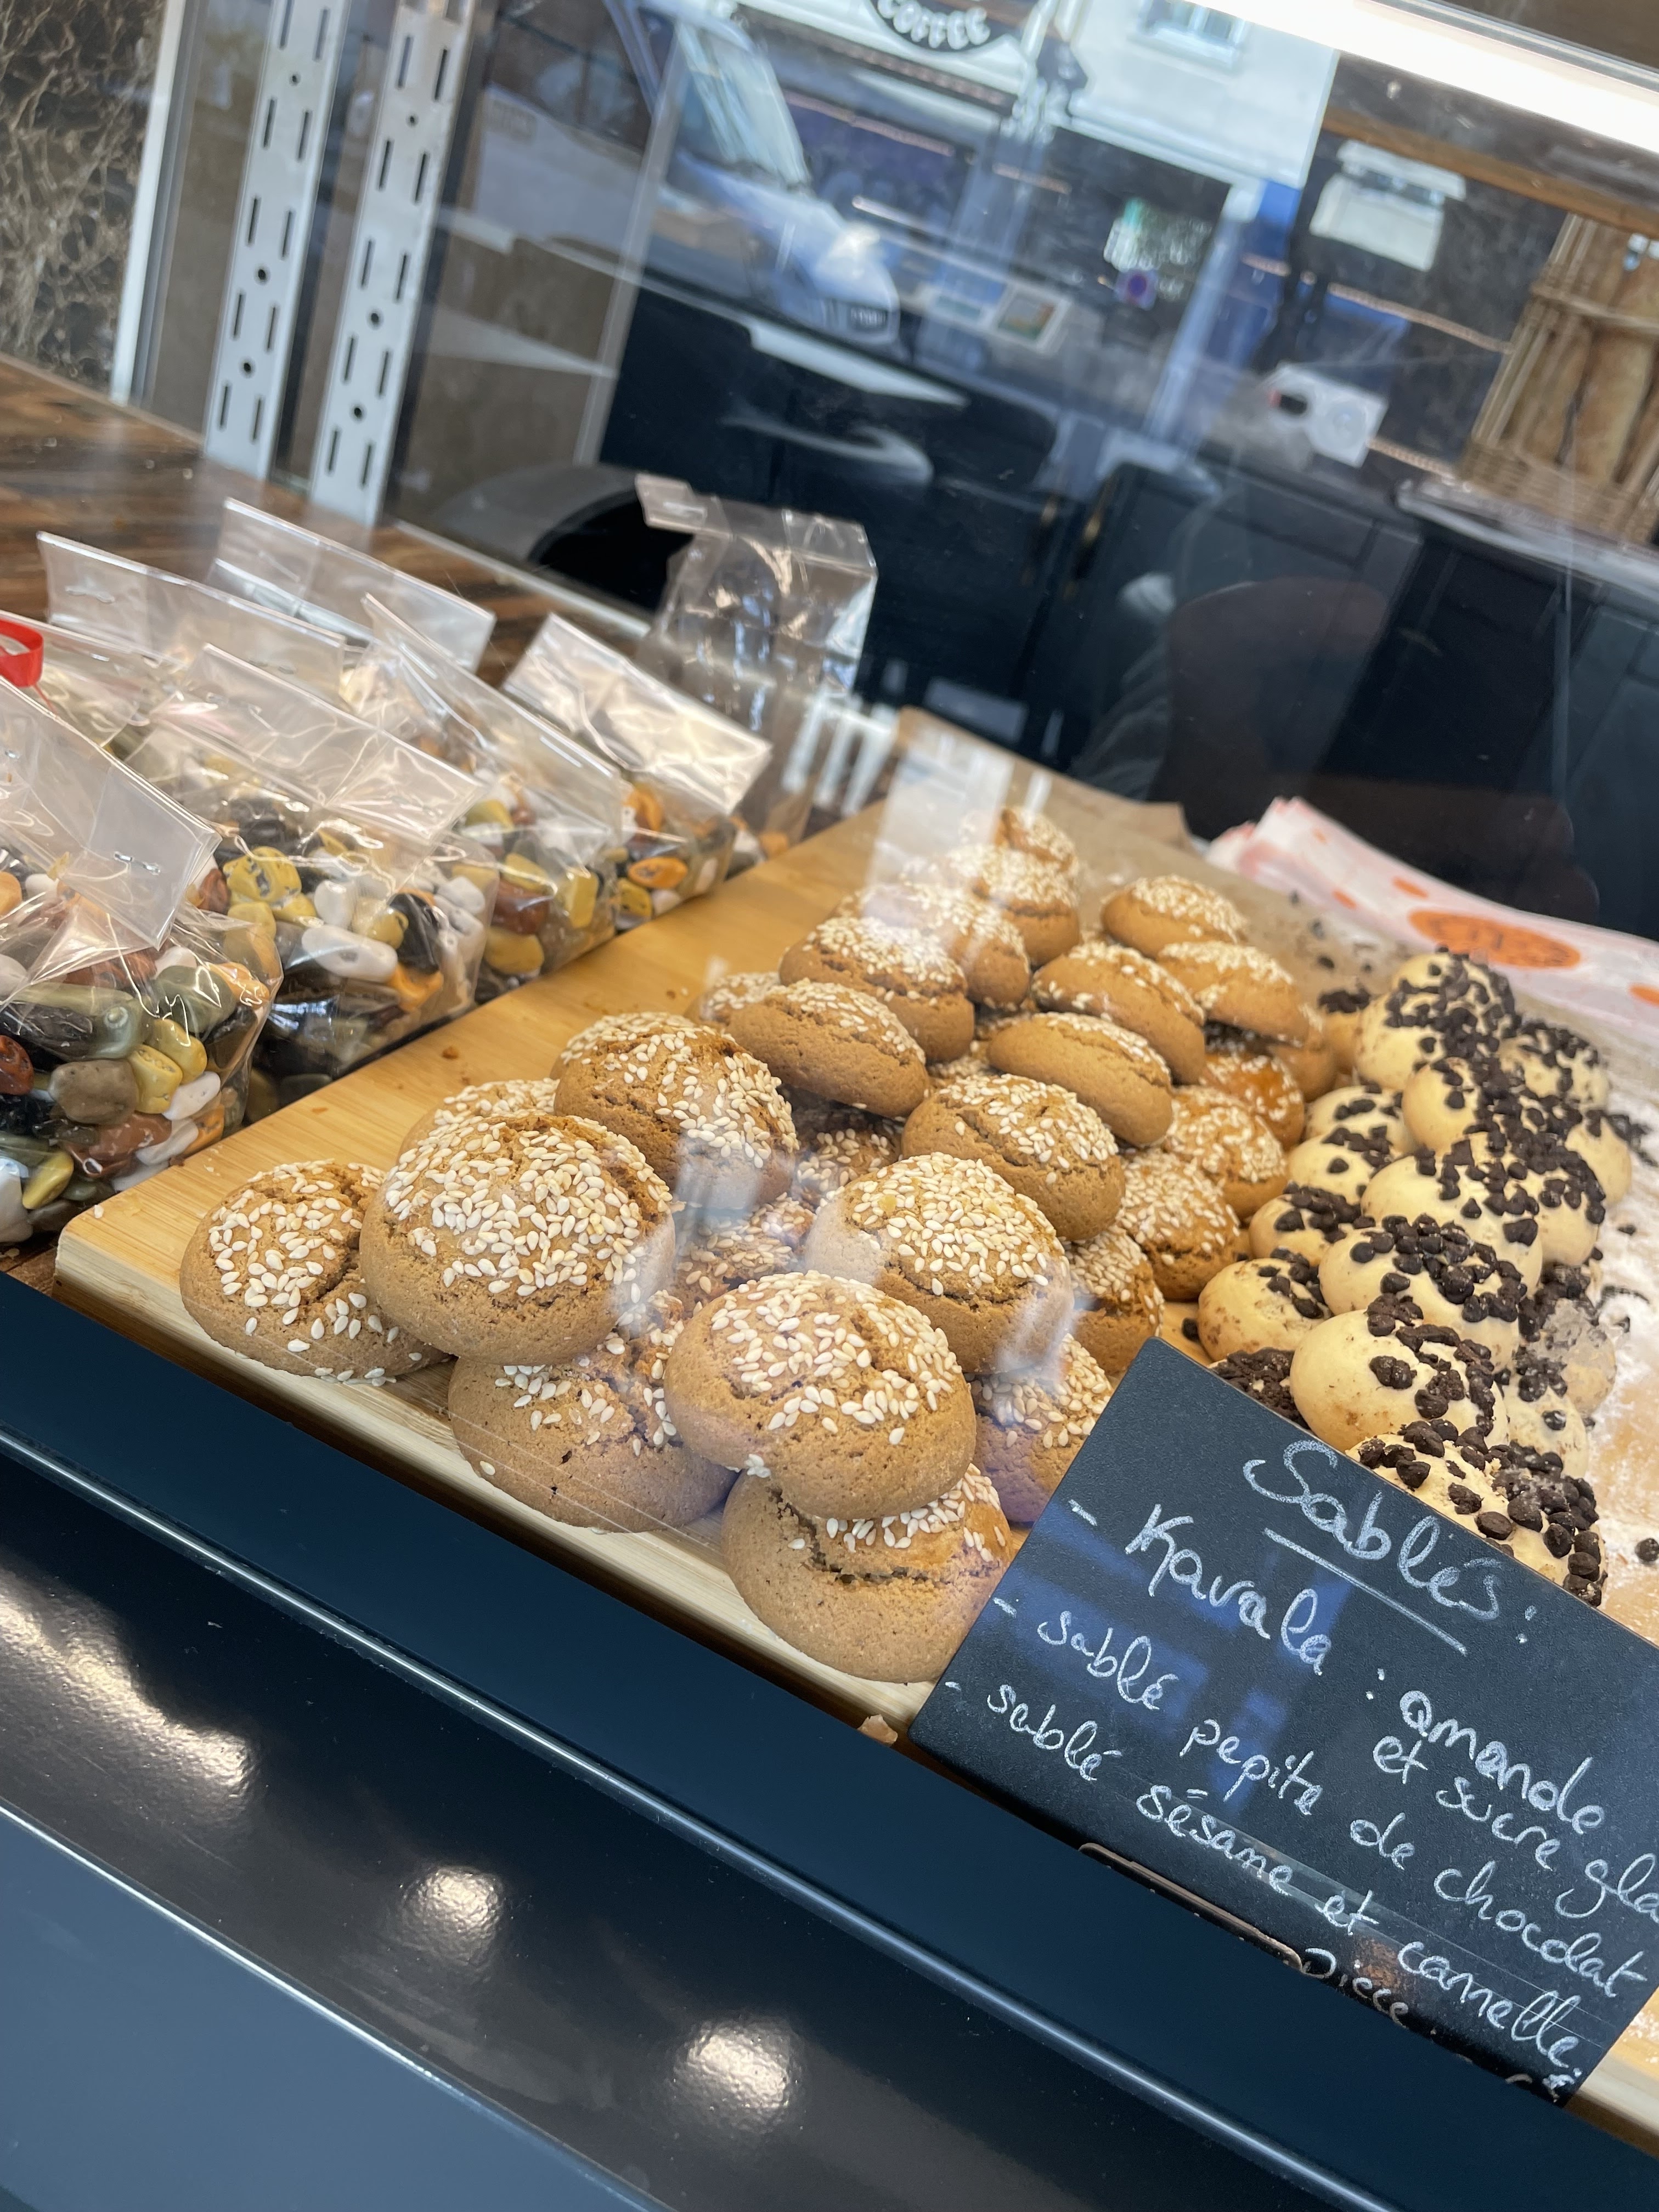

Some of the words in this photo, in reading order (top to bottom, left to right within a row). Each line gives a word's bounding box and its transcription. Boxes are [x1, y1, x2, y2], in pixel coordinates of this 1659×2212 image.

[987, 1684, 1122, 1781] sablé
[1136, 1785, 1293, 1897] sésame
[1314, 1889, 1380, 1936] et
[1037, 1610, 1180, 1711] sablé
[1350, 1812, 1415, 1871] de
[1434, 1860, 1647, 1998] chocolat
[1124, 1504, 1333, 1675] Kavala
[1400, 1690, 1605, 1835] amande
[1373, 1735, 1428, 1784] et
[1435, 1776, 1561, 1872] sucre
